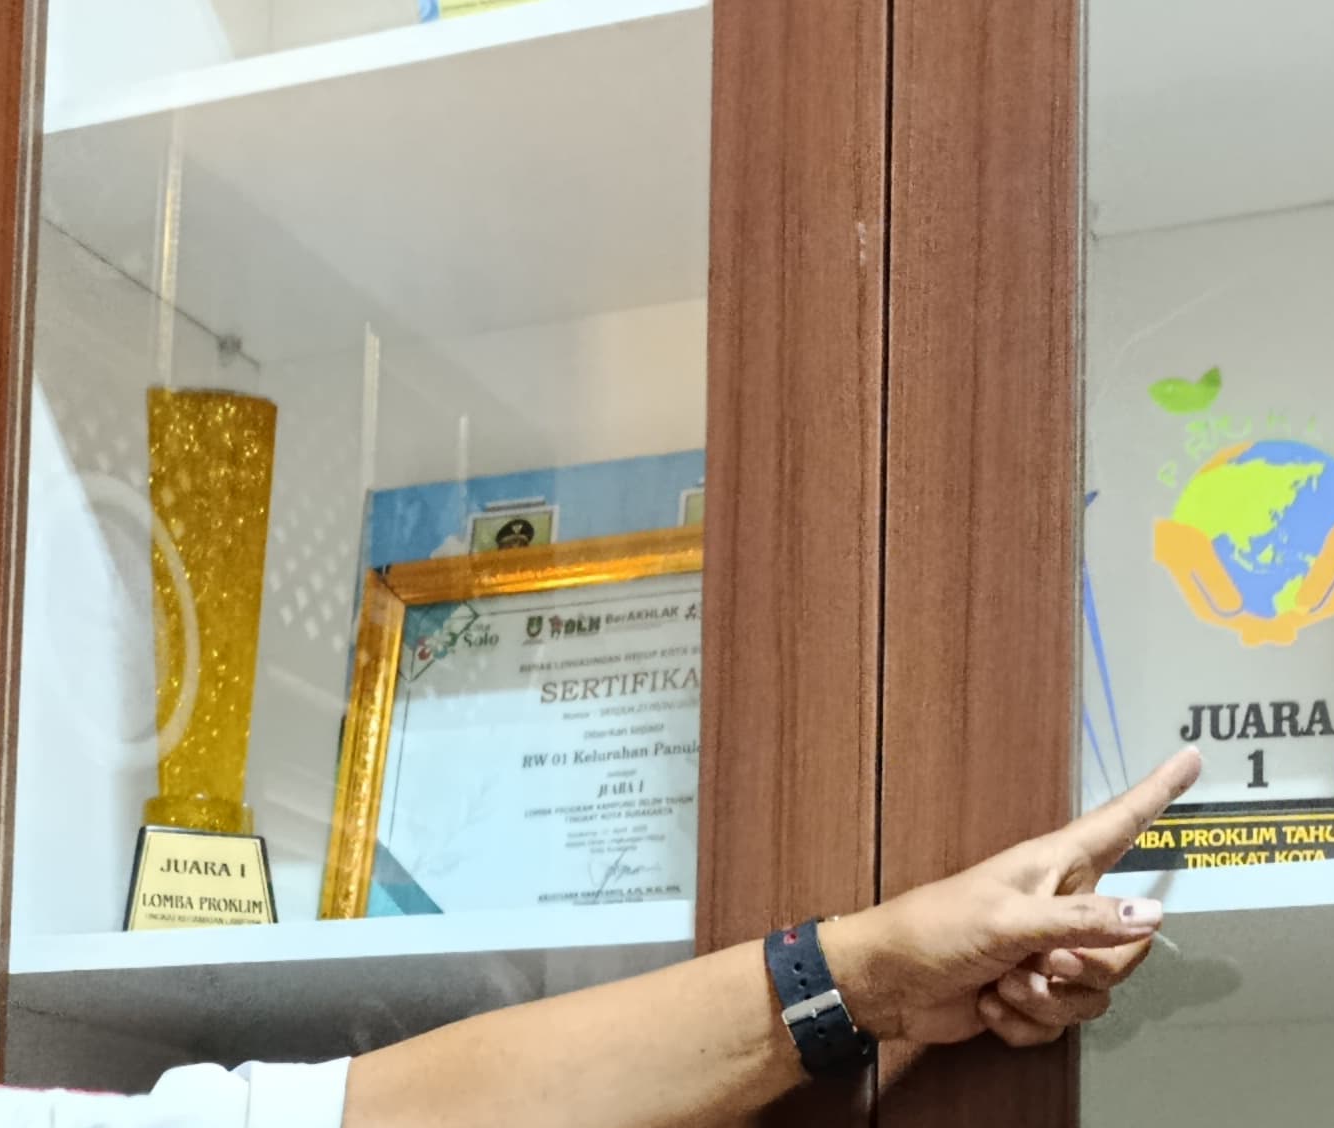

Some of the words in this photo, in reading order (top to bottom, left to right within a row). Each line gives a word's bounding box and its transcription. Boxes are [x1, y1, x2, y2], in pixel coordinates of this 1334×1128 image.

[540, 667, 700, 704] SERTIFIKA
[522, 752, 549, 768] RW
[551, 753, 568, 766] 01
[573, 745, 648, 764] Kelurahan
[1247, 749, 1269, 788] 1
[1135, 826, 1175, 849] MBA
[1181, 827, 1277, 848] PROKLIM
[160, 858, 232, 877] JUARA
[1185, 850, 1269, 869] TINGKAT
[142, 893, 194, 909] LOMBA
[199, 896, 263, 914] PROKLIM
